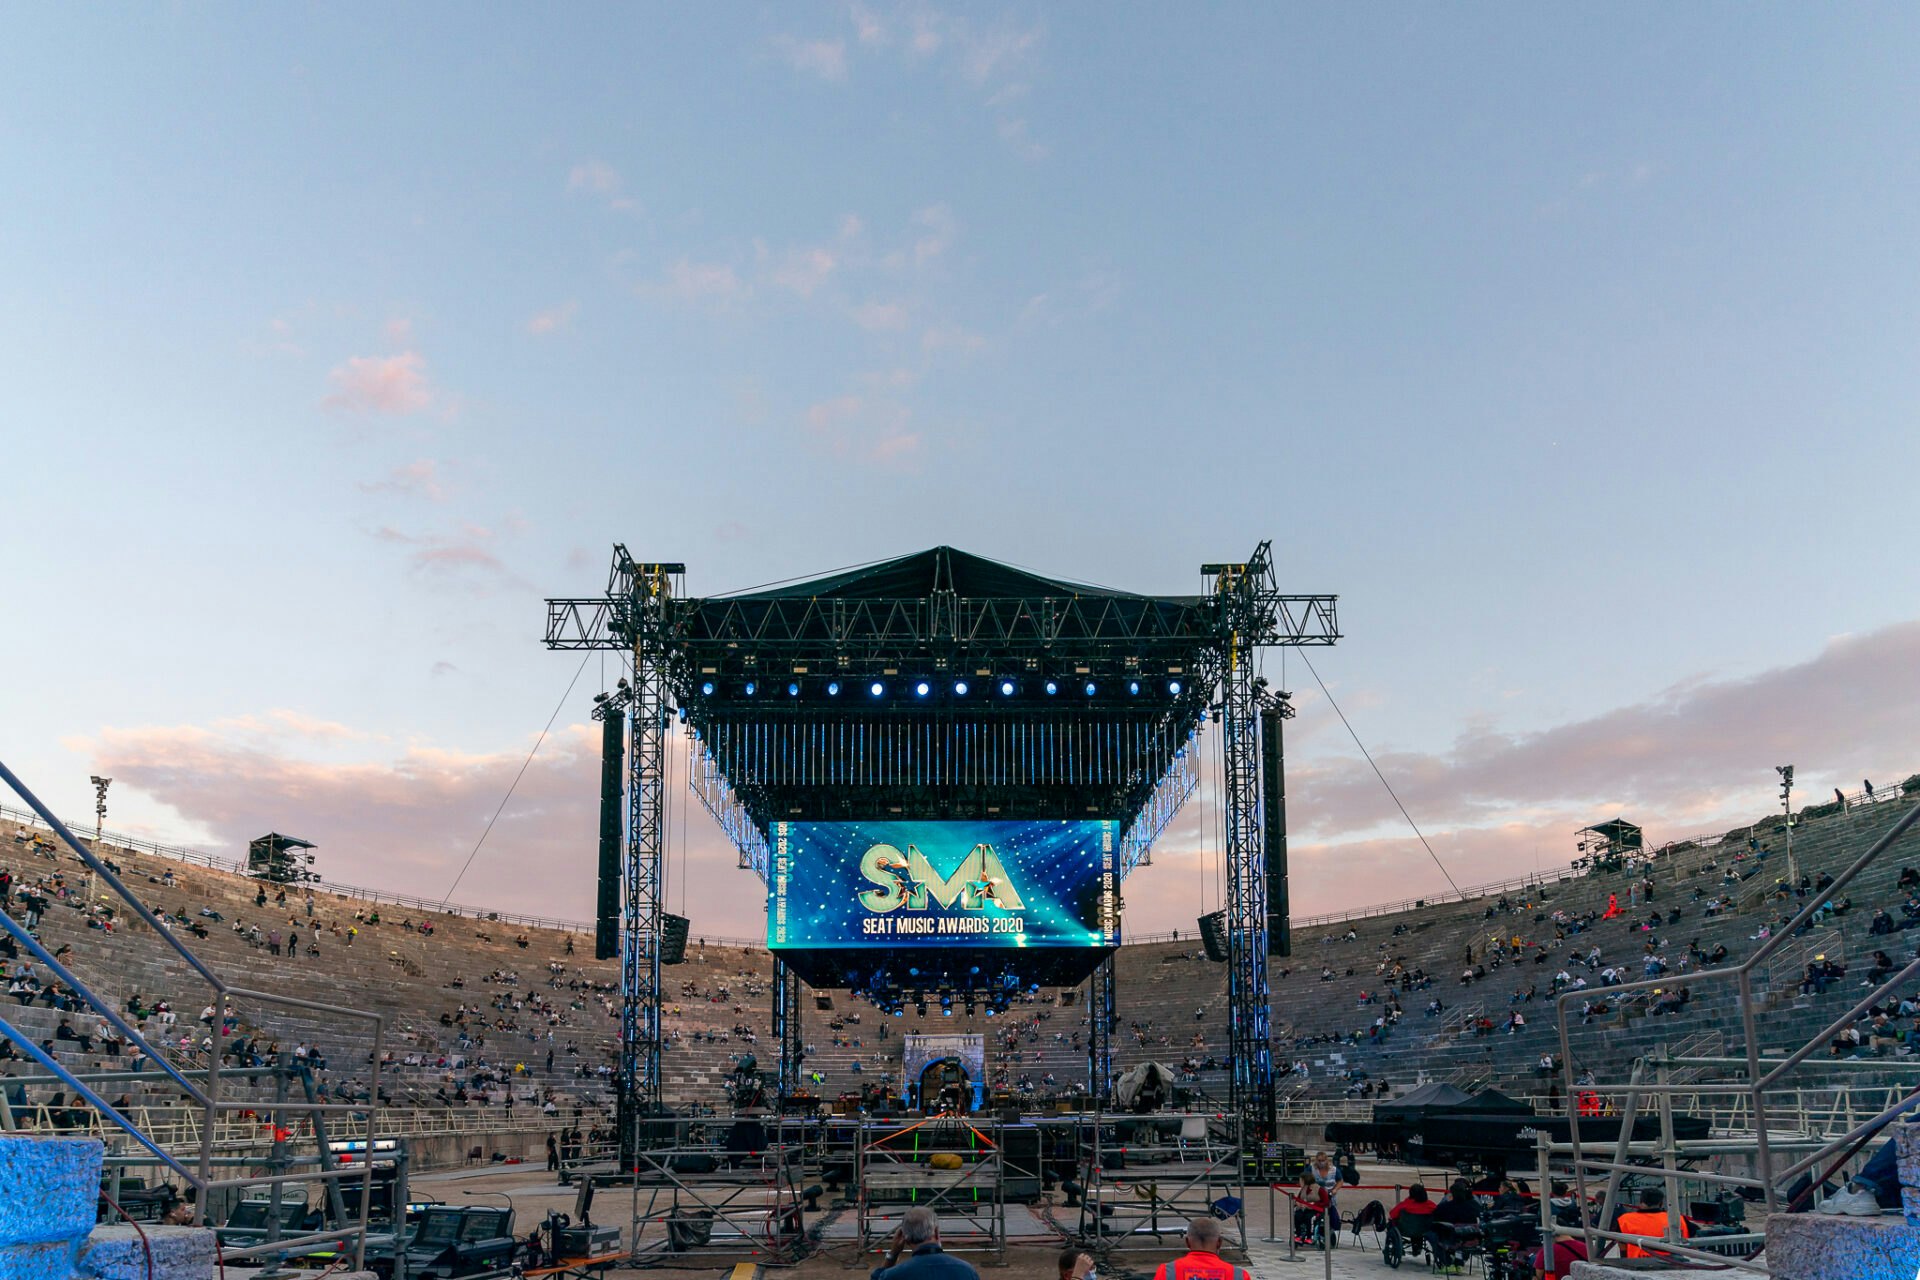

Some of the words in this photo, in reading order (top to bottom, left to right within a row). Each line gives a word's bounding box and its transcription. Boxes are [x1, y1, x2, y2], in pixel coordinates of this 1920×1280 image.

[858, 843, 1026, 913] SMA
[1103, 872, 1113, 889] 2020
[1103, 890, 1113, 917] AWARDS
[863, 918, 894, 934] SEAT
[896, 917, 935, 934] MUSIC
[938, 917, 990, 933] AWARDS
[993, 917, 1024, 933] 2020
[1104, 919, 1113, 940] MUSIC
